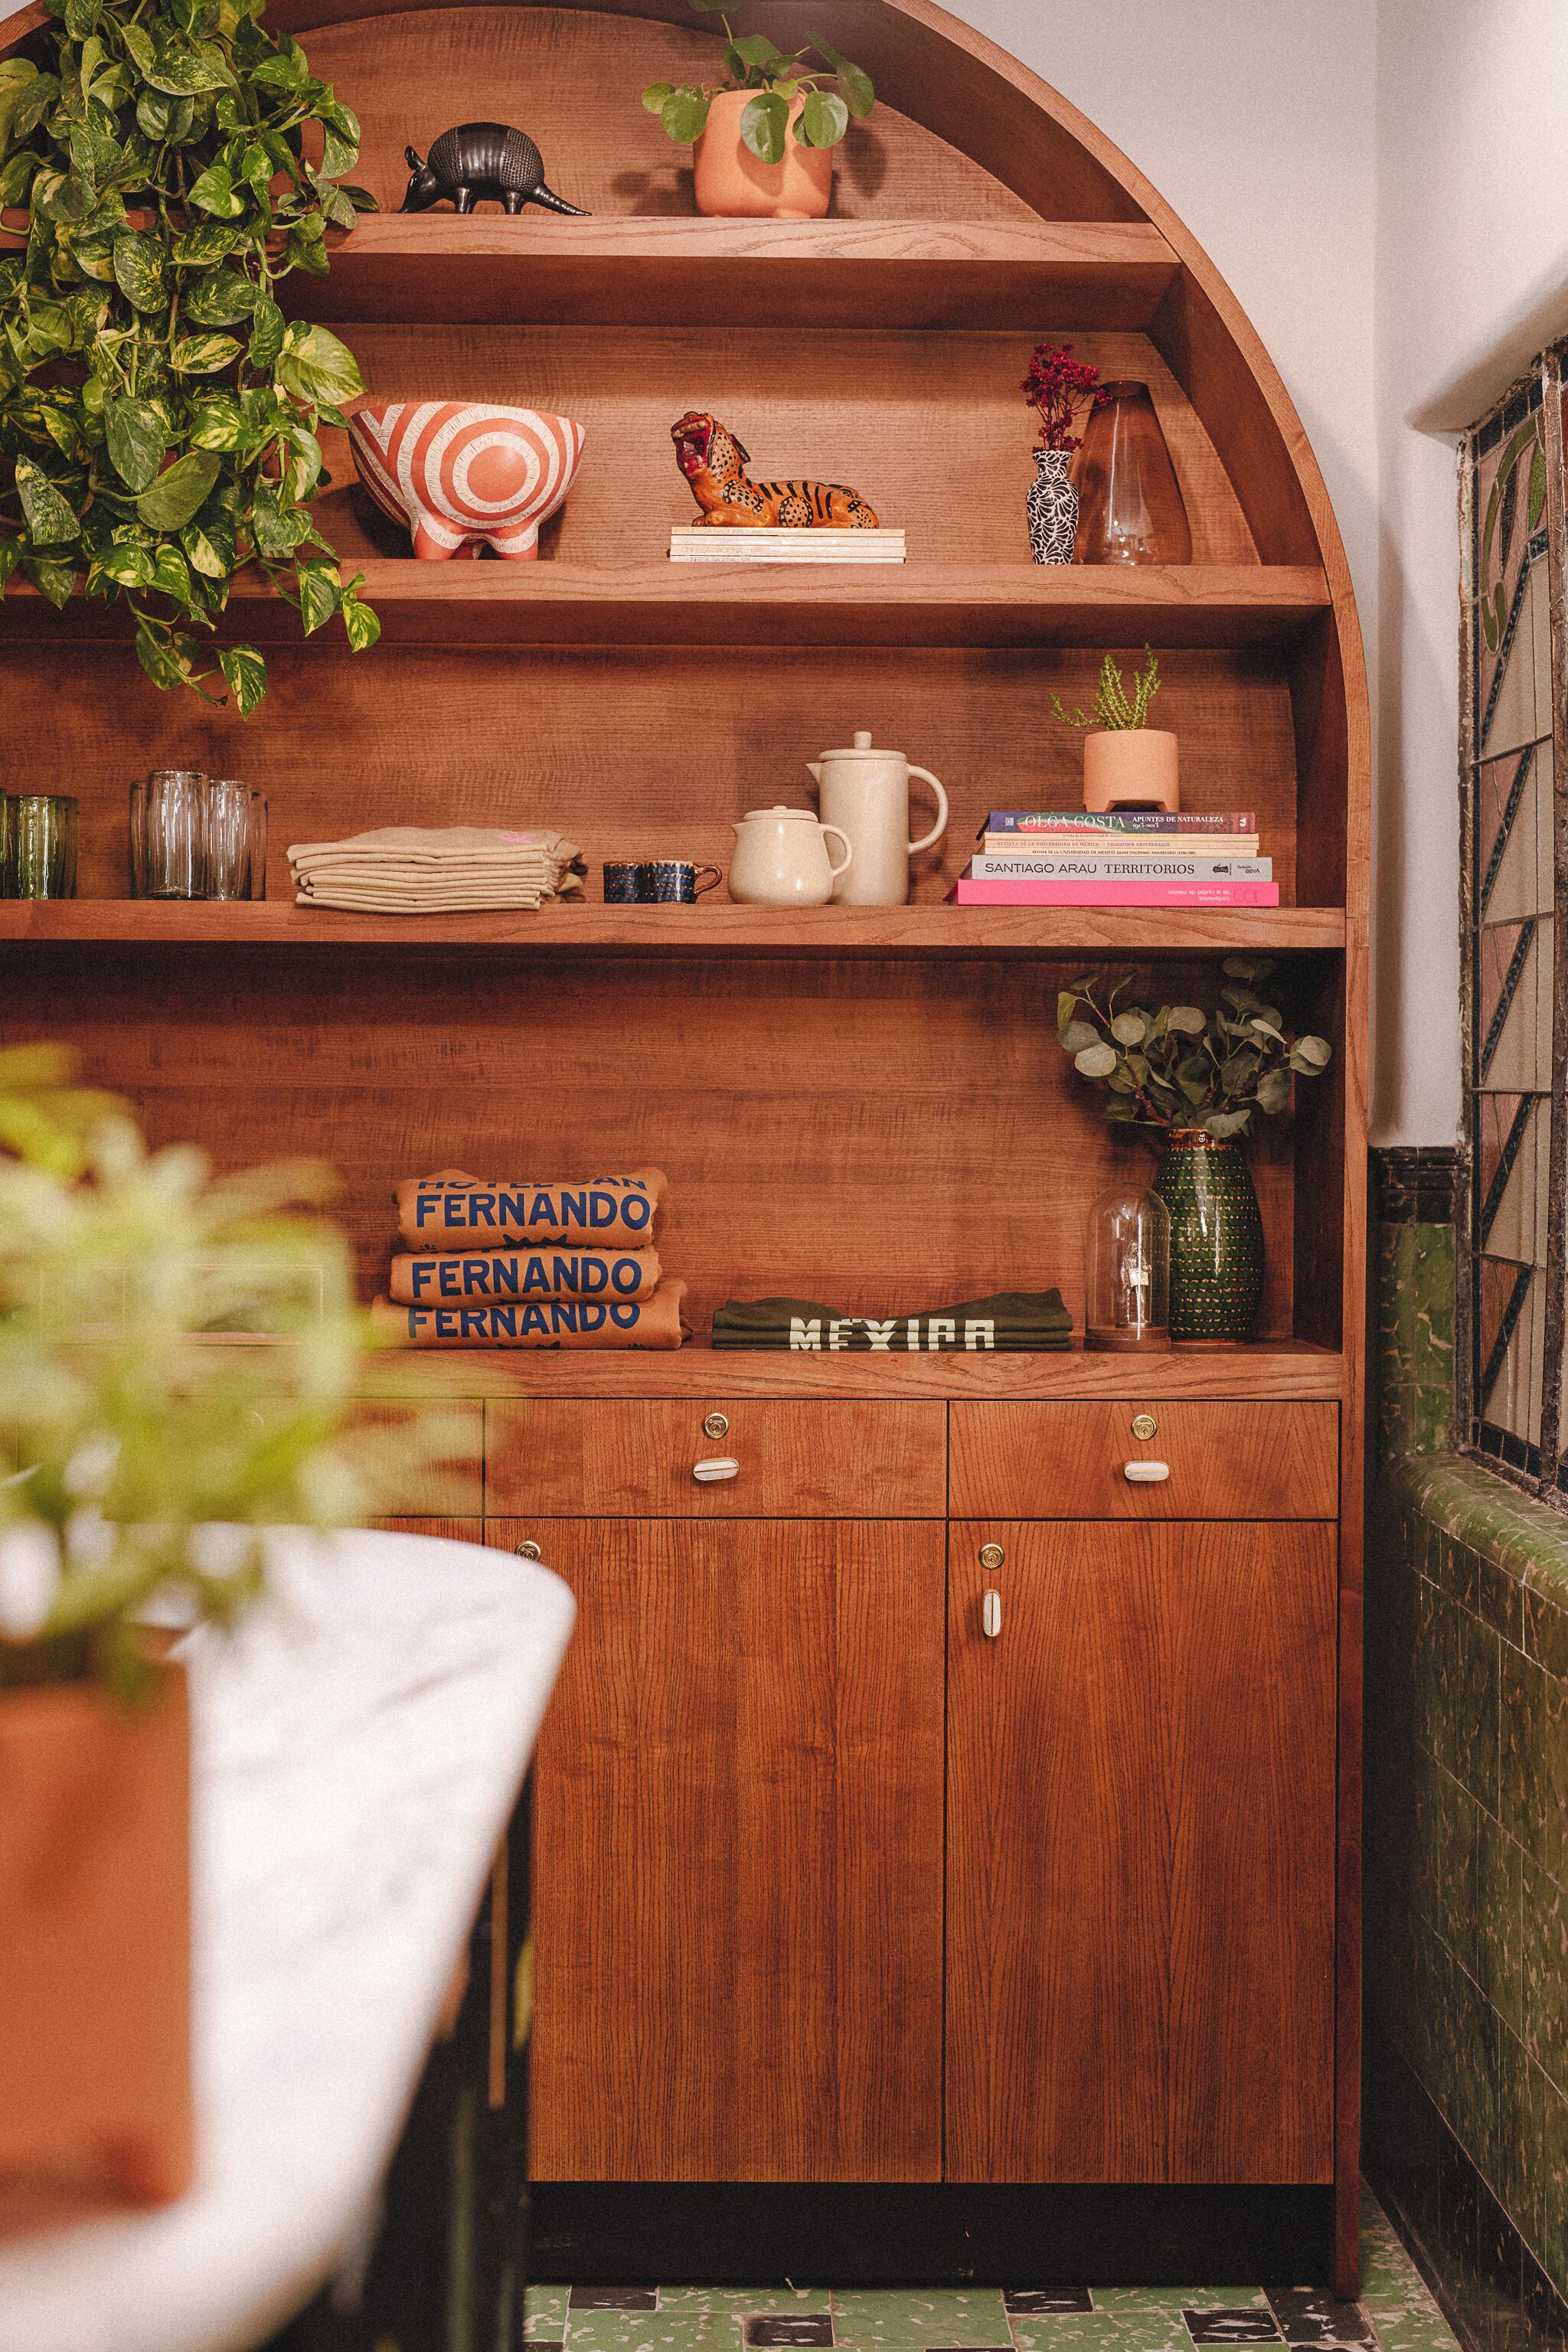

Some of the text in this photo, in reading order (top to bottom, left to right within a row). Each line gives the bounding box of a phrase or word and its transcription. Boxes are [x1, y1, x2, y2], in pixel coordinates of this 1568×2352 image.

[1025, 815, 1125, 828] OLGA COSTA
[985, 863, 1194, 874] SANTIAGO ARAU TERRITORIOS
[568, 1177, 647, 1191] AN
[416, 1191, 651, 1230] FERNANDO
[411, 1256, 642, 1298] FERNANDO
[408, 1303, 641, 1338] FERNANDO
